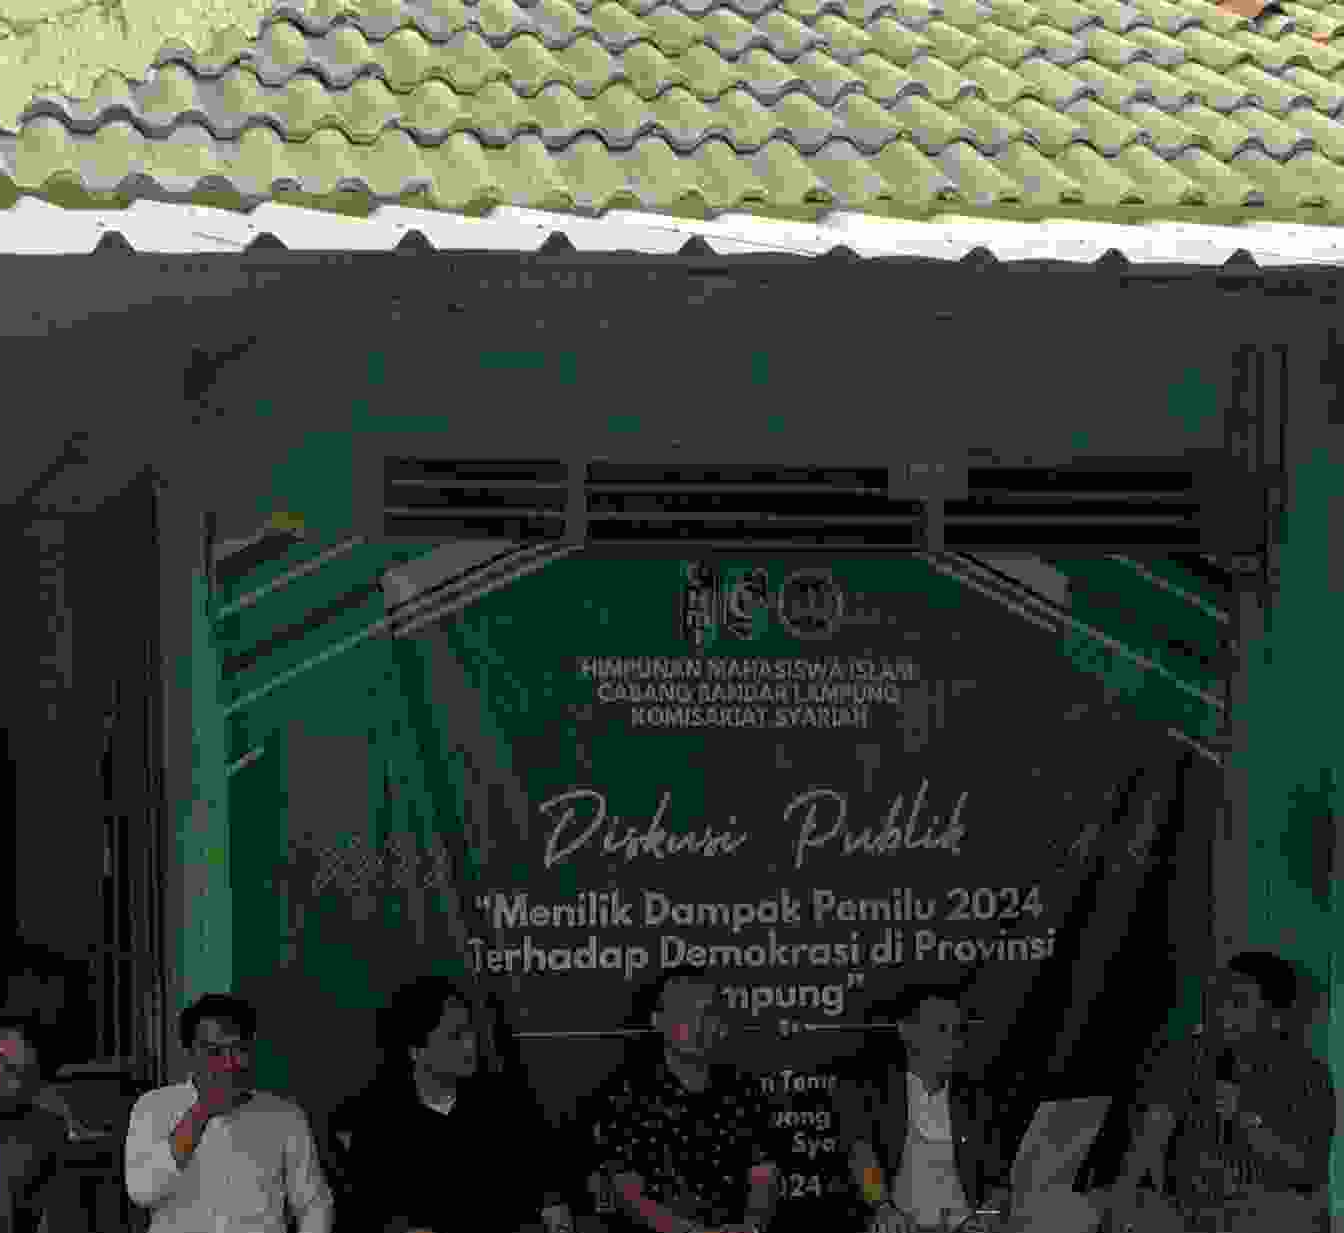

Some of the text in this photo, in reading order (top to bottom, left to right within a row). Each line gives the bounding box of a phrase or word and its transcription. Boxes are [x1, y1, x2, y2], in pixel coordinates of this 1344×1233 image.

[707, 657, 843, 681] MAHASISWA
[538, 787, 752, 870] Diskusi
[783, 776, 969, 870] Publik
[644, 889, 801, 932] Dampak
[813, 887, 937, 921] Pemilu
[944, 886, 1045, 920] 2024
[466, 927, 1057, 979] Terhadap Demokrasi di Provinsi
